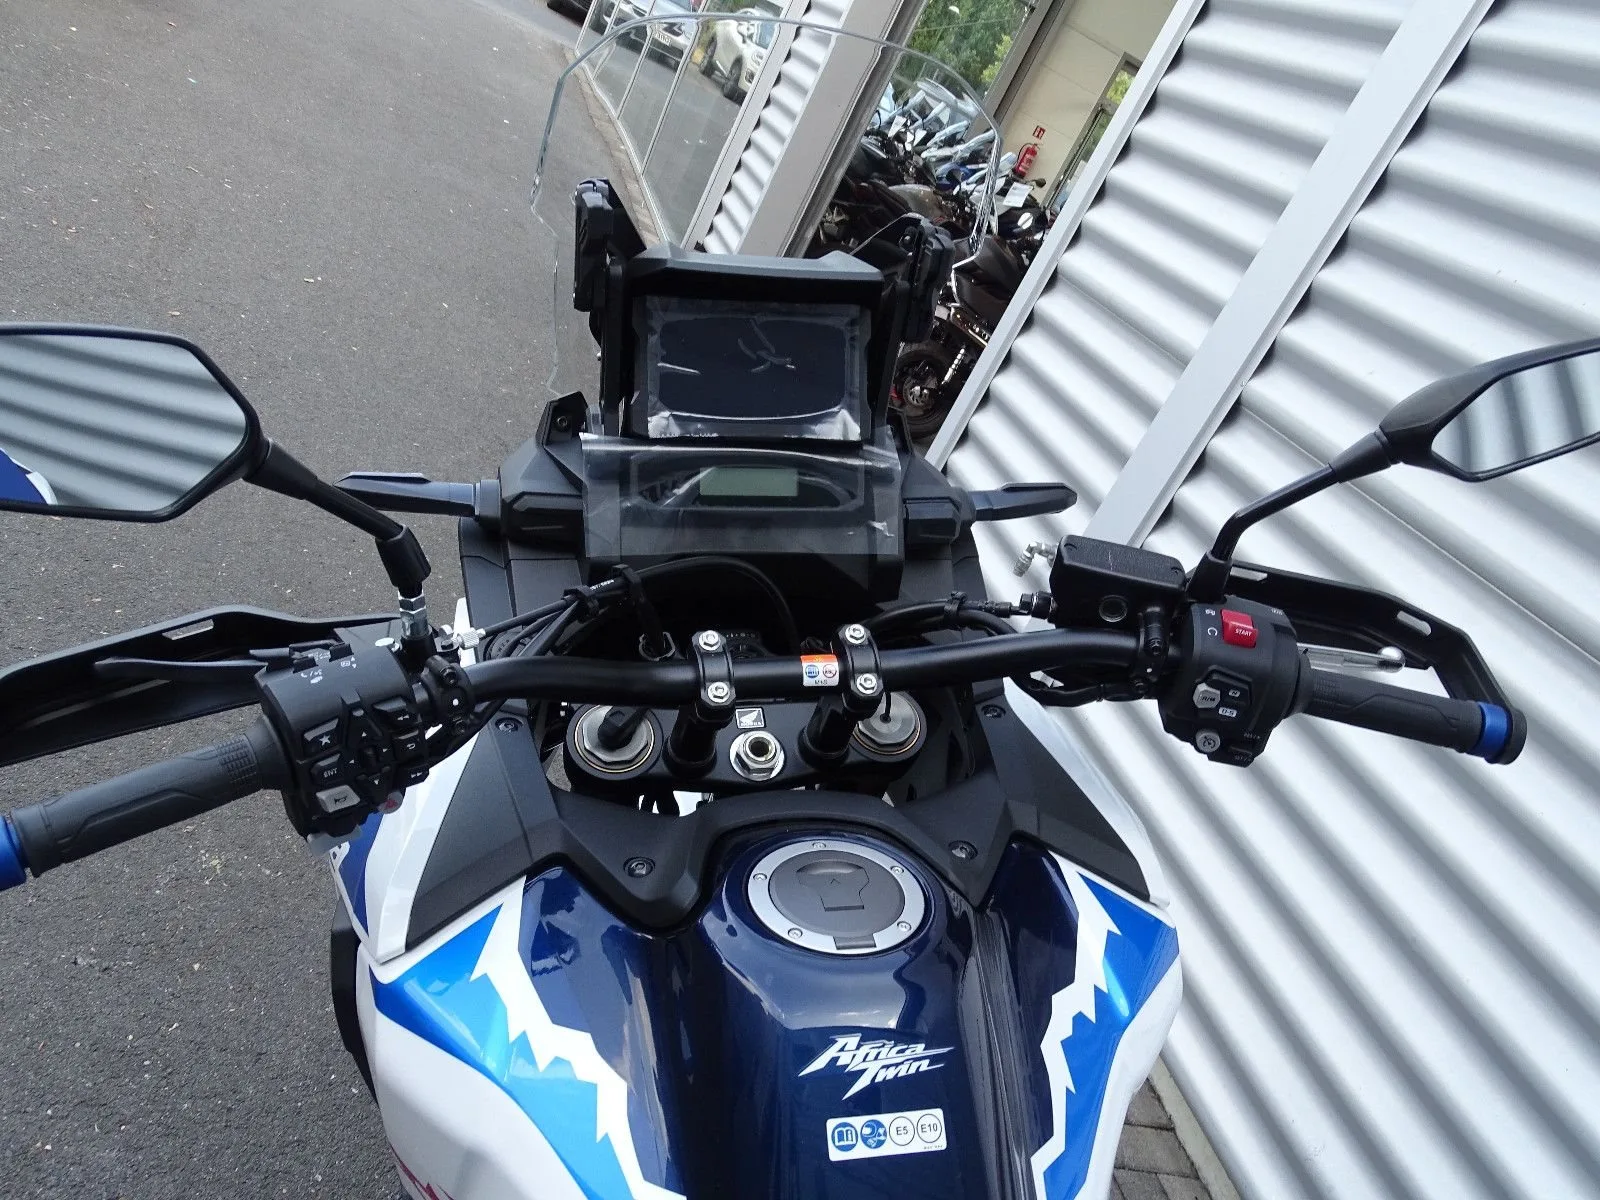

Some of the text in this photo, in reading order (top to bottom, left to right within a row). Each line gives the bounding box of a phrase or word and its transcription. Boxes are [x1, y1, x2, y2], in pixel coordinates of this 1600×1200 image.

[1235, 628, 1252, 637] START
[798, 1033, 955, 1077] Africa
[842, 1058, 945, 1100] Twin
[895, 1122, 938, 1136] E5 E10
